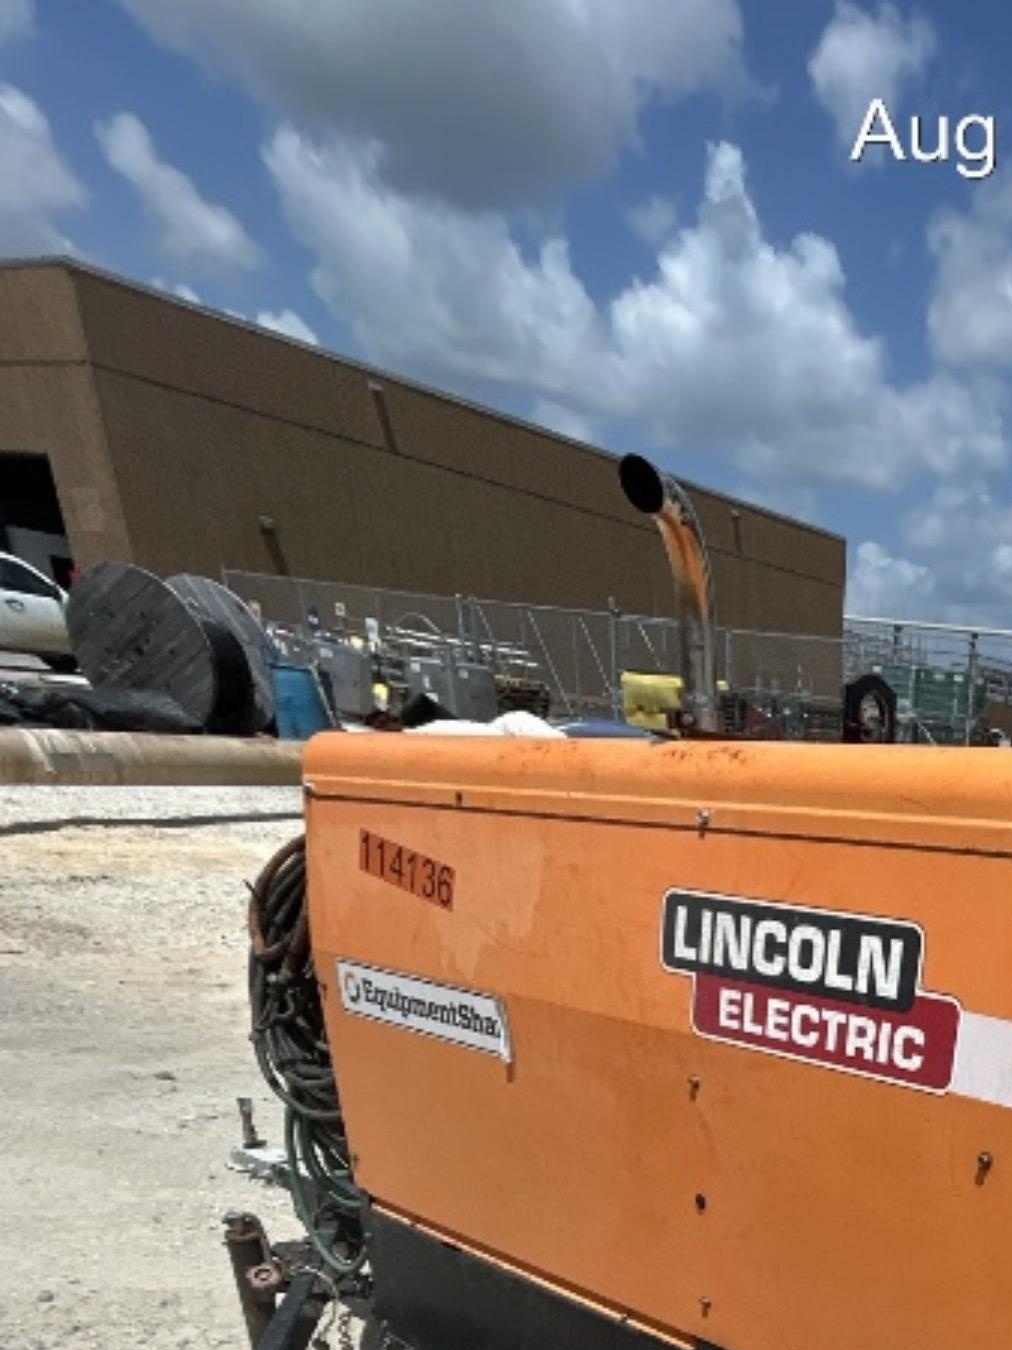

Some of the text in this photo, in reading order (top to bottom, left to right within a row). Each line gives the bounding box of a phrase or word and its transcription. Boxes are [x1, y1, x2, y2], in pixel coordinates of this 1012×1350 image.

[361, 831, 454, 908] 114136
[674, 904, 904, 1000] LINCOLN
[719, 987, 926, 1072] ELECTRIC
